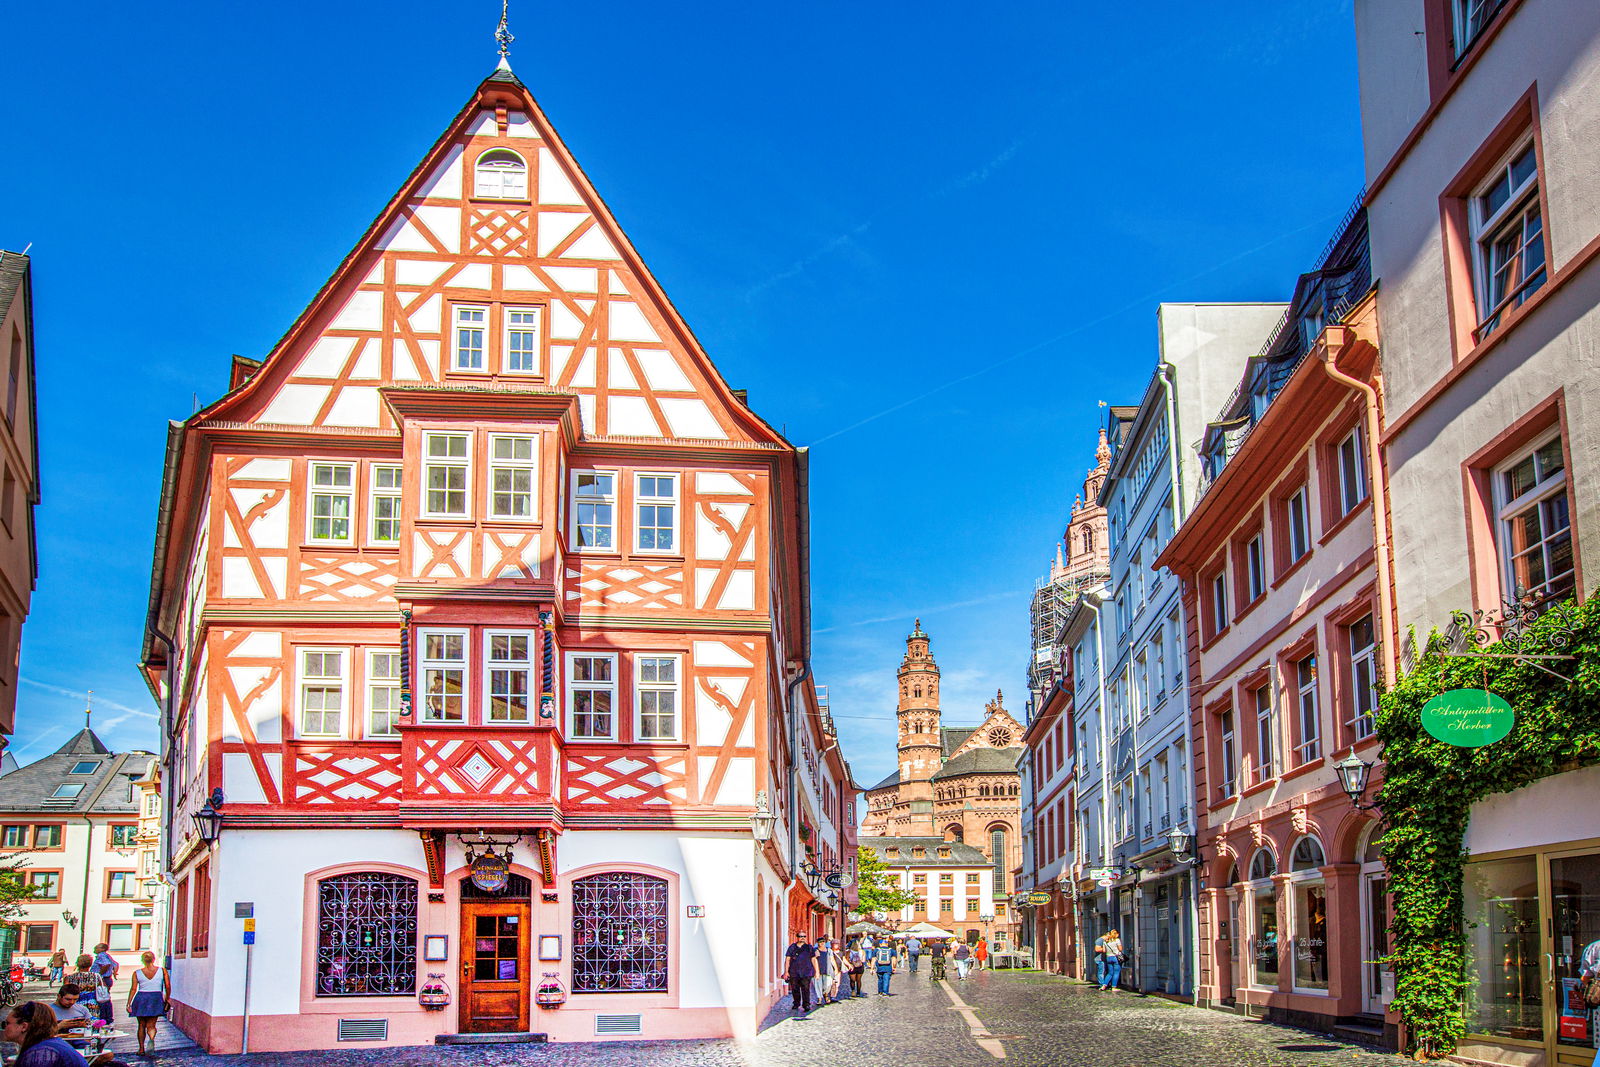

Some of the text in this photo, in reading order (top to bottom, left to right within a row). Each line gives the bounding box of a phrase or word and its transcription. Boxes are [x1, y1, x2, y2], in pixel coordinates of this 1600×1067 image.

[1431, 705, 1504, 718] Antiquitäten
[1448, 719, 1492, 730] Herber
[1299, 937, 1307, 947] 25
